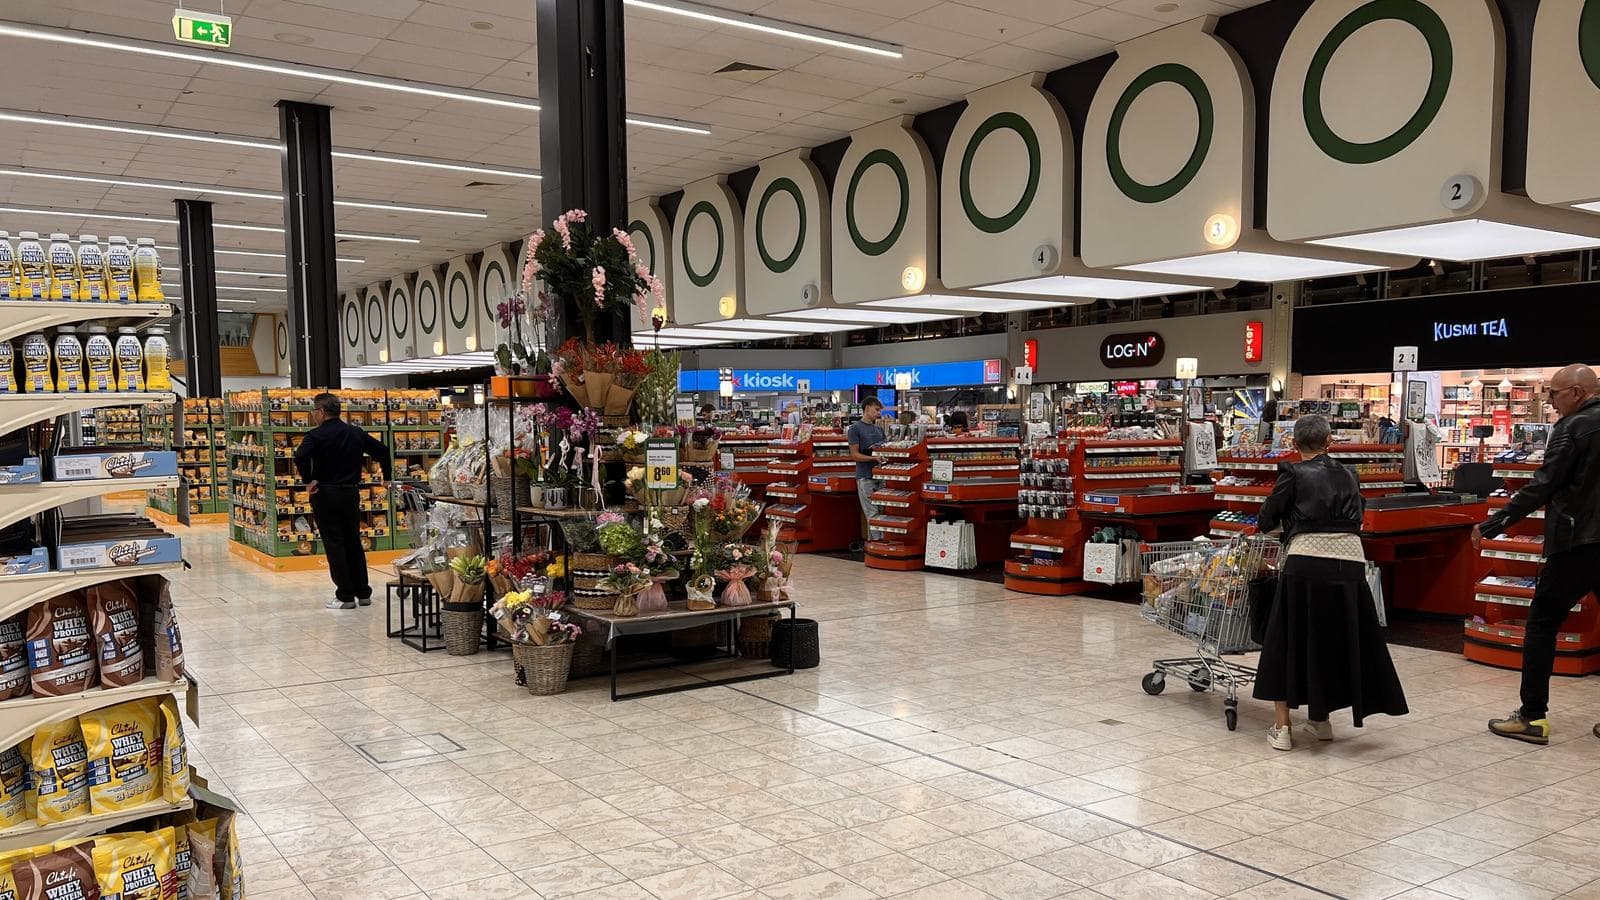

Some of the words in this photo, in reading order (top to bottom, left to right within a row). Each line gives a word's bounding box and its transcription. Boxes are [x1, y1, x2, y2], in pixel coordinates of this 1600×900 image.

[1451, 183, 1462, 201] 2
[1213, 222, 1221, 237] 3
[1037, 250, 1044, 264] 4
[803, 288, 809, 299] 6
[1434, 322, 1477, 341] KUSMI
[1481, 318, 1508, 337] TEA
[1398, 353, 1405, 364] 2
[1411, 353, 1416, 364] 2
[743, 372, 794, 388] kiosk
[53, 617, 86, 631] WHEY
[109, 609, 134, 624] WHEY
[54, 627, 87, 638] PROTEIN
[112, 732, 142, 749] WHEY
[52, 742, 83, 759] WHEY
[114, 742, 144, 756] PROTEIN
[55, 751, 86, 766] PROTEIN
[122, 865, 155, 883] WHEY
[45, 879, 81, 900] WHEY
[125, 875, 156, 891] PROTEIN
